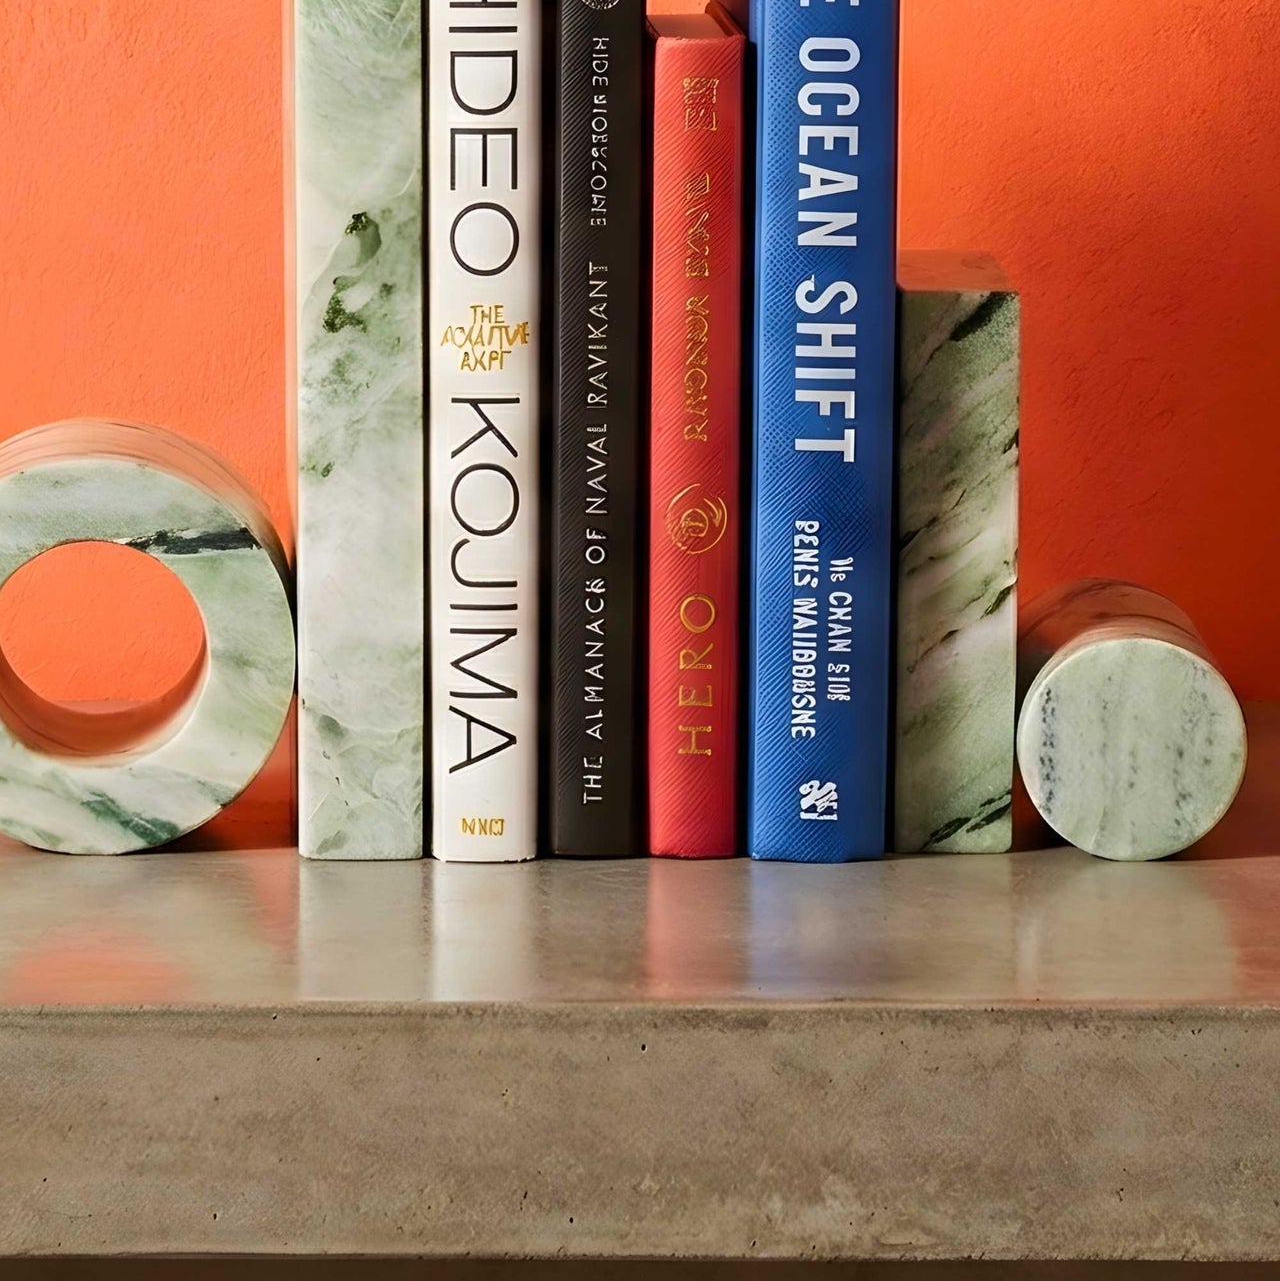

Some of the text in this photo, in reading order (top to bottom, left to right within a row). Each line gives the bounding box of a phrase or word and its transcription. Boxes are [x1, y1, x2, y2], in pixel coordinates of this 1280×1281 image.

[796, 36, 861, 248] OCEAN
[469, 304, 505, 324] THE
[793, 273, 859, 465] SHIFT
[585, 421, 609, 516] NAVAL
[447, 395, 522, 776] KOJIMA
[585, 526, 607, 566] OF
[677, 591, 718, 757] HERO
[582, 755, 604, 805] THE
